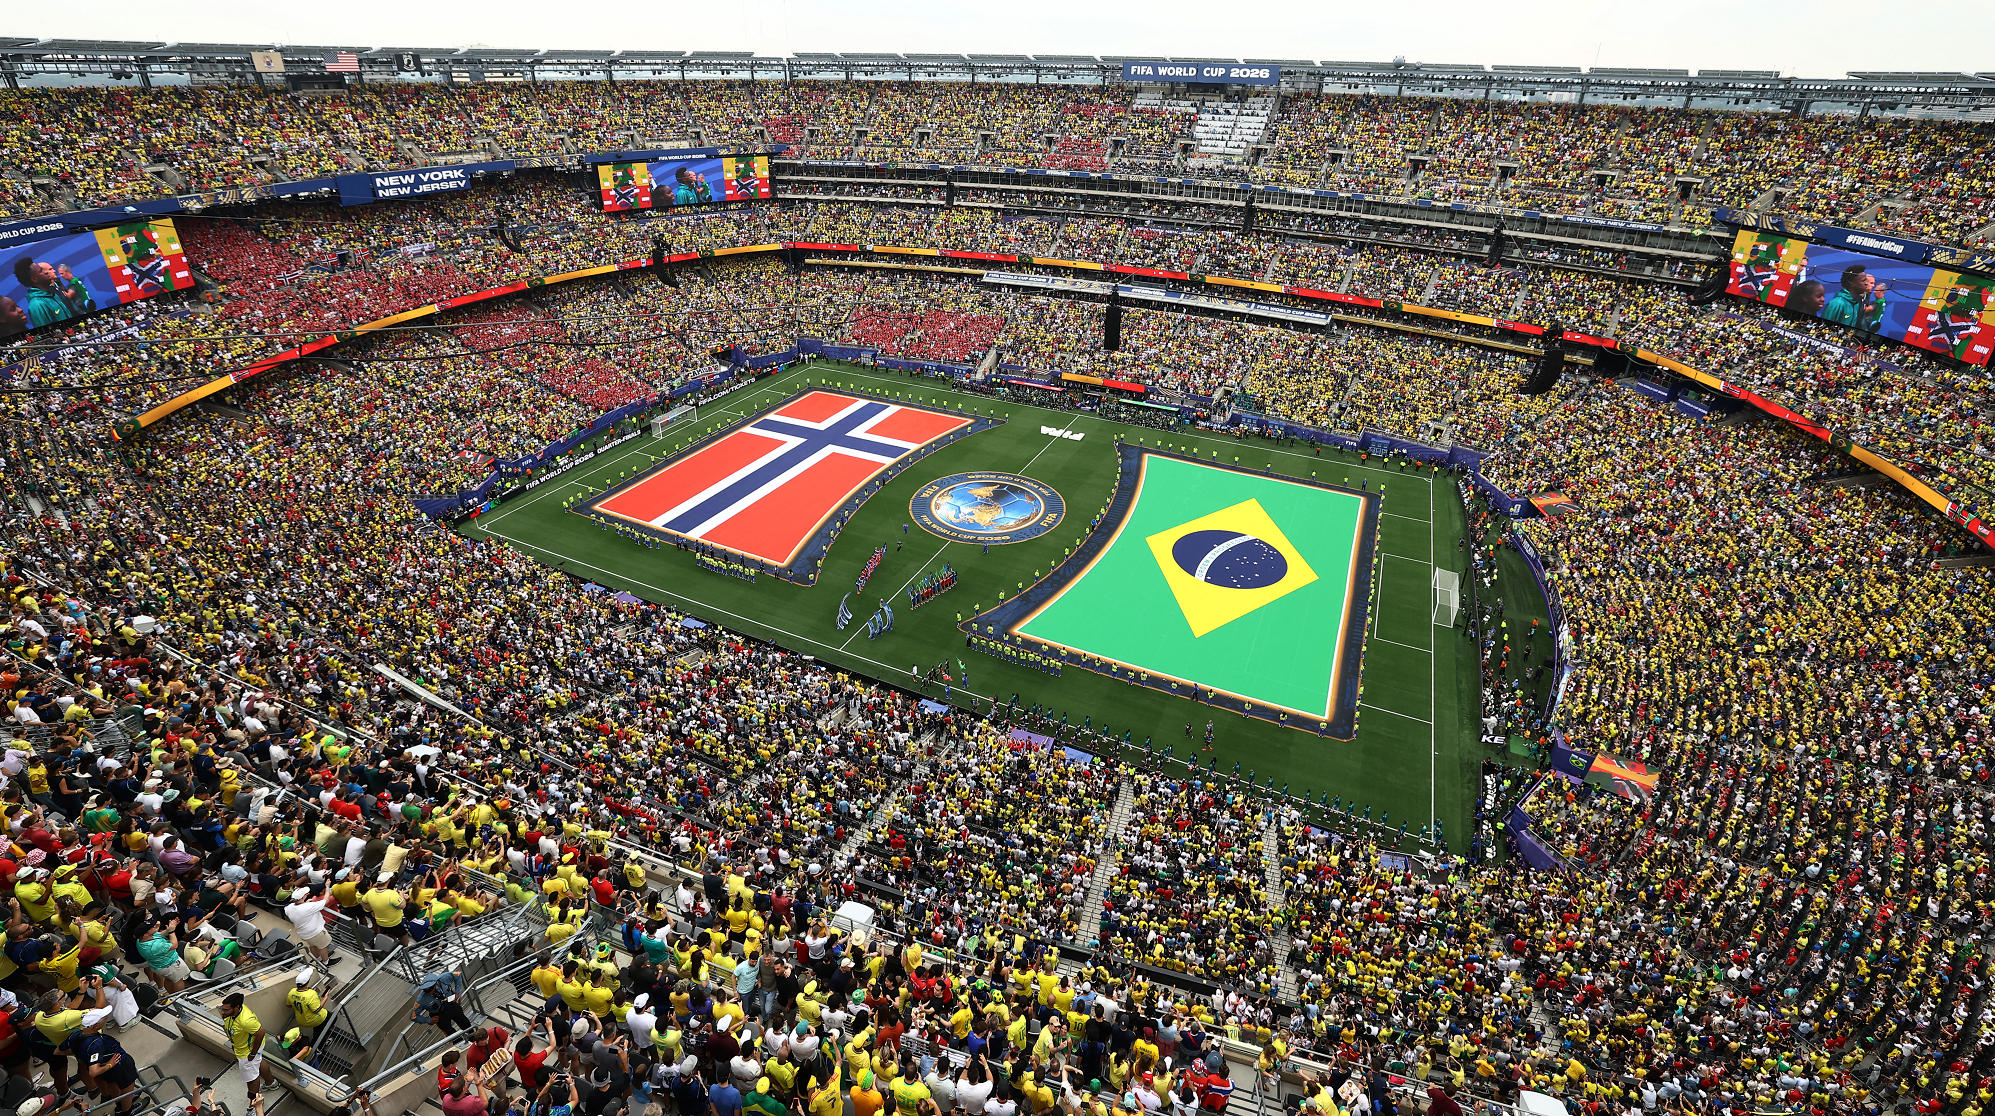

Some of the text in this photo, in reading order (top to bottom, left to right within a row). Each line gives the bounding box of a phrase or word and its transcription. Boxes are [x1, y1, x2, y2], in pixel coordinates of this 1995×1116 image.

[1130, 65, 1270, 78] FIFA WORLD CUP 2026
[375, 169, 466, 188] NEW YORK
[378, 180, 466, 198] NEW JERSEY
[20, 227, 36, 235] CUP
[36, 223, 64, 232] 2026
[1846, 234, 1904, 254] #FIFAWorldCup
[1772, 327, 1784, 336] FIFA
[1784, 331, 1807, 342] WORLD
[698, 377, 756, 407] FIFA.COM/TICKETS
[1040, 425, 1085, 441] FIFA
[525, 429, 642, 490] FIFA WORLD CUP 2026 QUARTER-FINALS
[920, 515, 933, 525] FIFA
[932, 523, 957, 538] WORLD
[958, 532, 976, 540] CUP
[1040, 513, 1058, 527] FIFA
[1481, 735, 1505, 744] KE
[1074, 1022, 1083, 1031] 10
[827, 1097, 836, 1108] 7
